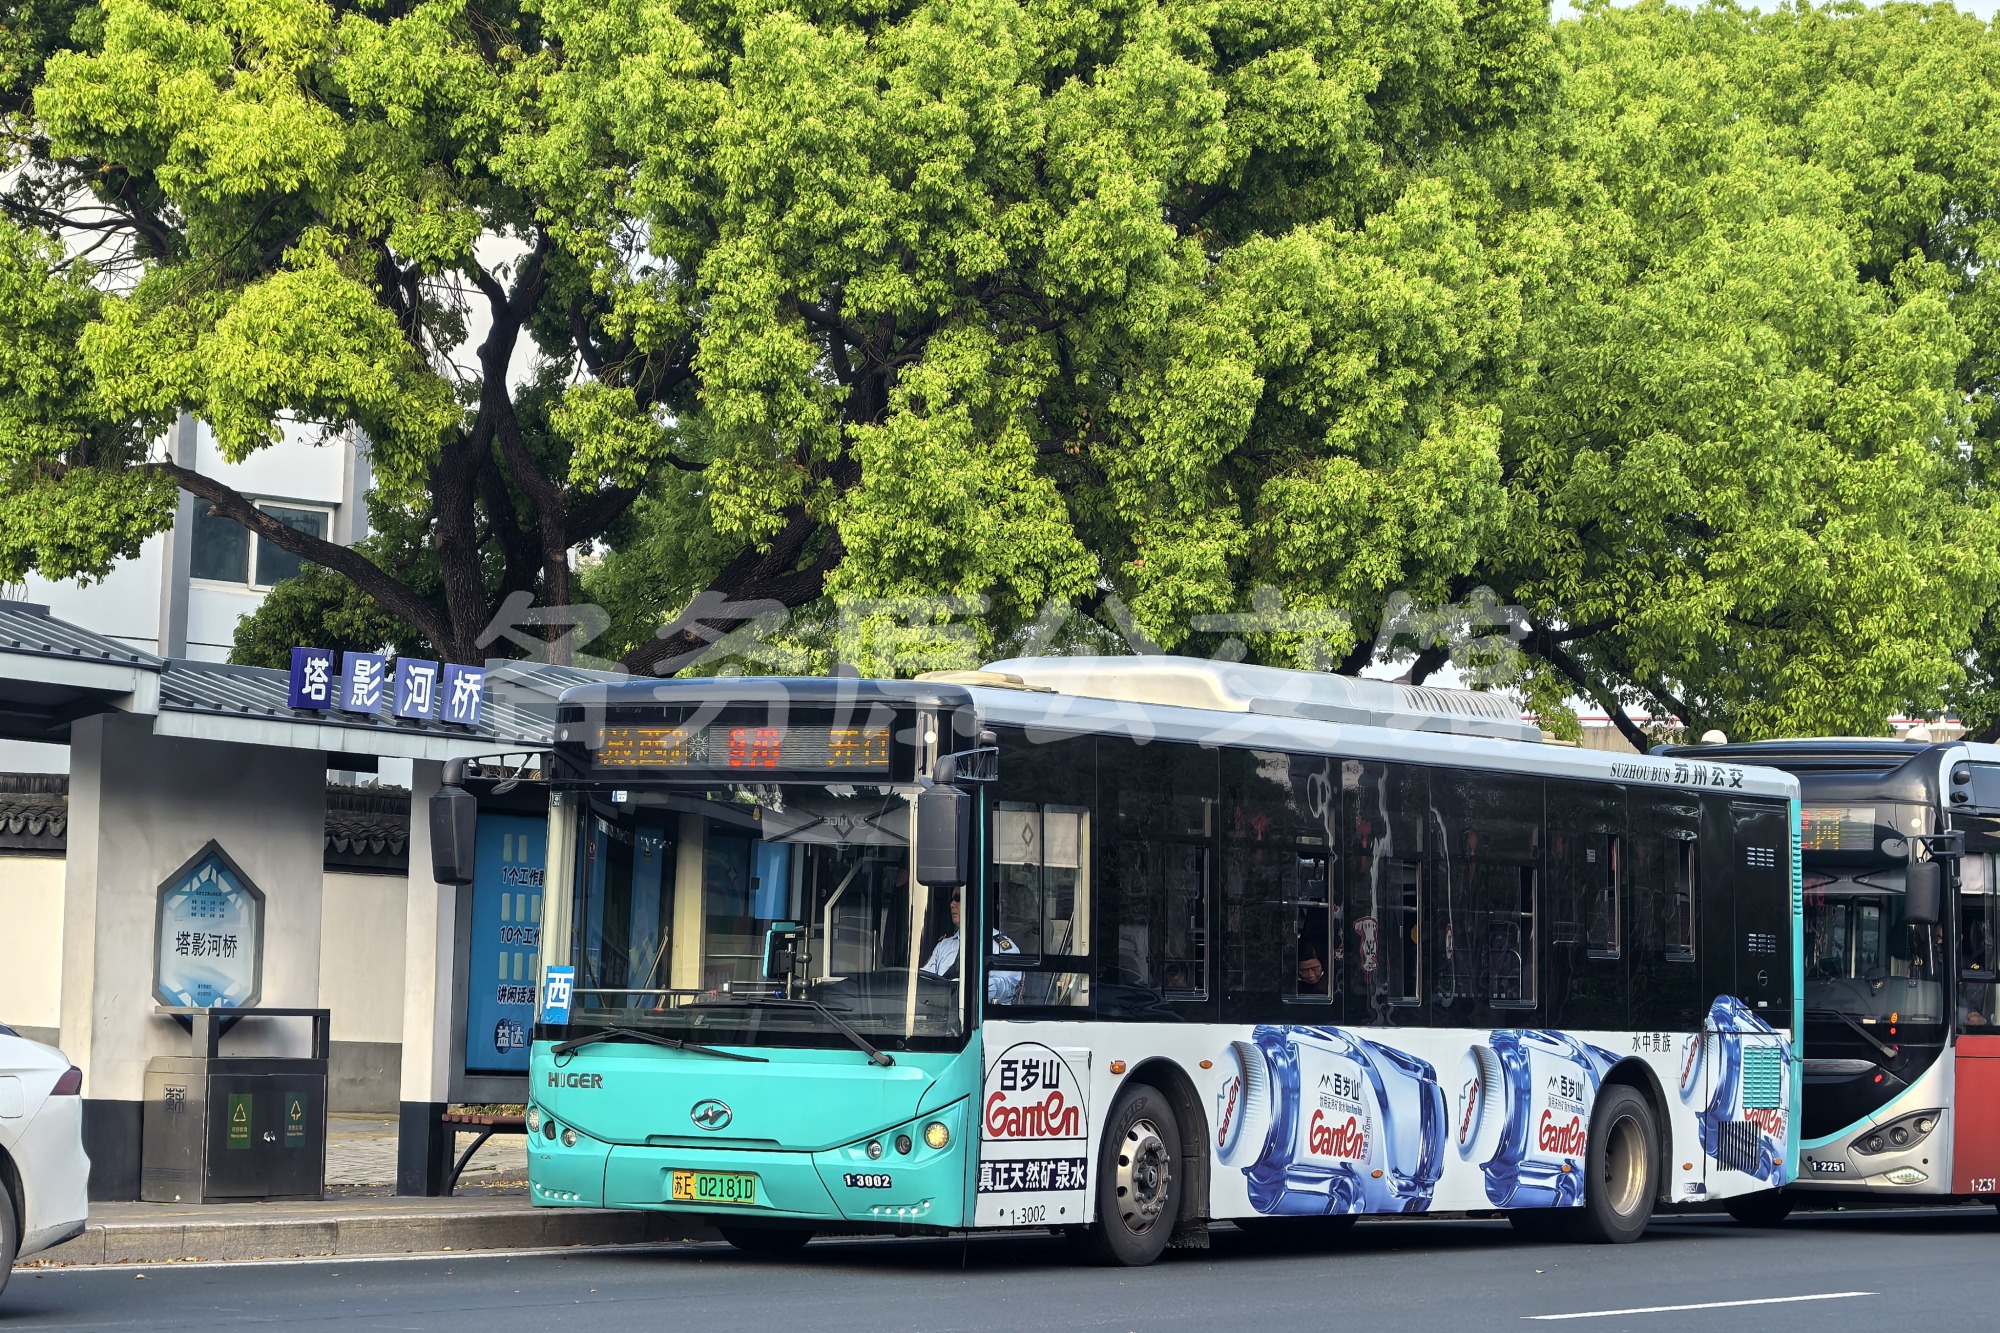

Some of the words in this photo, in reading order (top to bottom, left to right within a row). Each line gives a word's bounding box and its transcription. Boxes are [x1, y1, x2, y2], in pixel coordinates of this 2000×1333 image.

[301, 656, 482, 720] 塔影河桥
[1610, 762, 1651, 780] SUZHOU
[1651, 766, 1671, 783] BUS
[1673, 762, 1744, 789] 苏州公交
[175, 930, 238, 959] 塔影河桥
[546, 972, 574, 1010] 西
[496, 1024, 524, 1048] 益达
[1632, 1032, 1672, 1053] 水中贵族
[548, 1072, 603, 1089] HIGER
[1000, 1058, 1060, 1091] 百岁山
[1334, 1072, 1361, 1101] 百岁山
[1560, 1074, 1584, 1102] 百岁山
[978, 1159, 1085, 1192] 真正天然矿泉水
[1010, 1204, 1046, 1226] 1-3002
